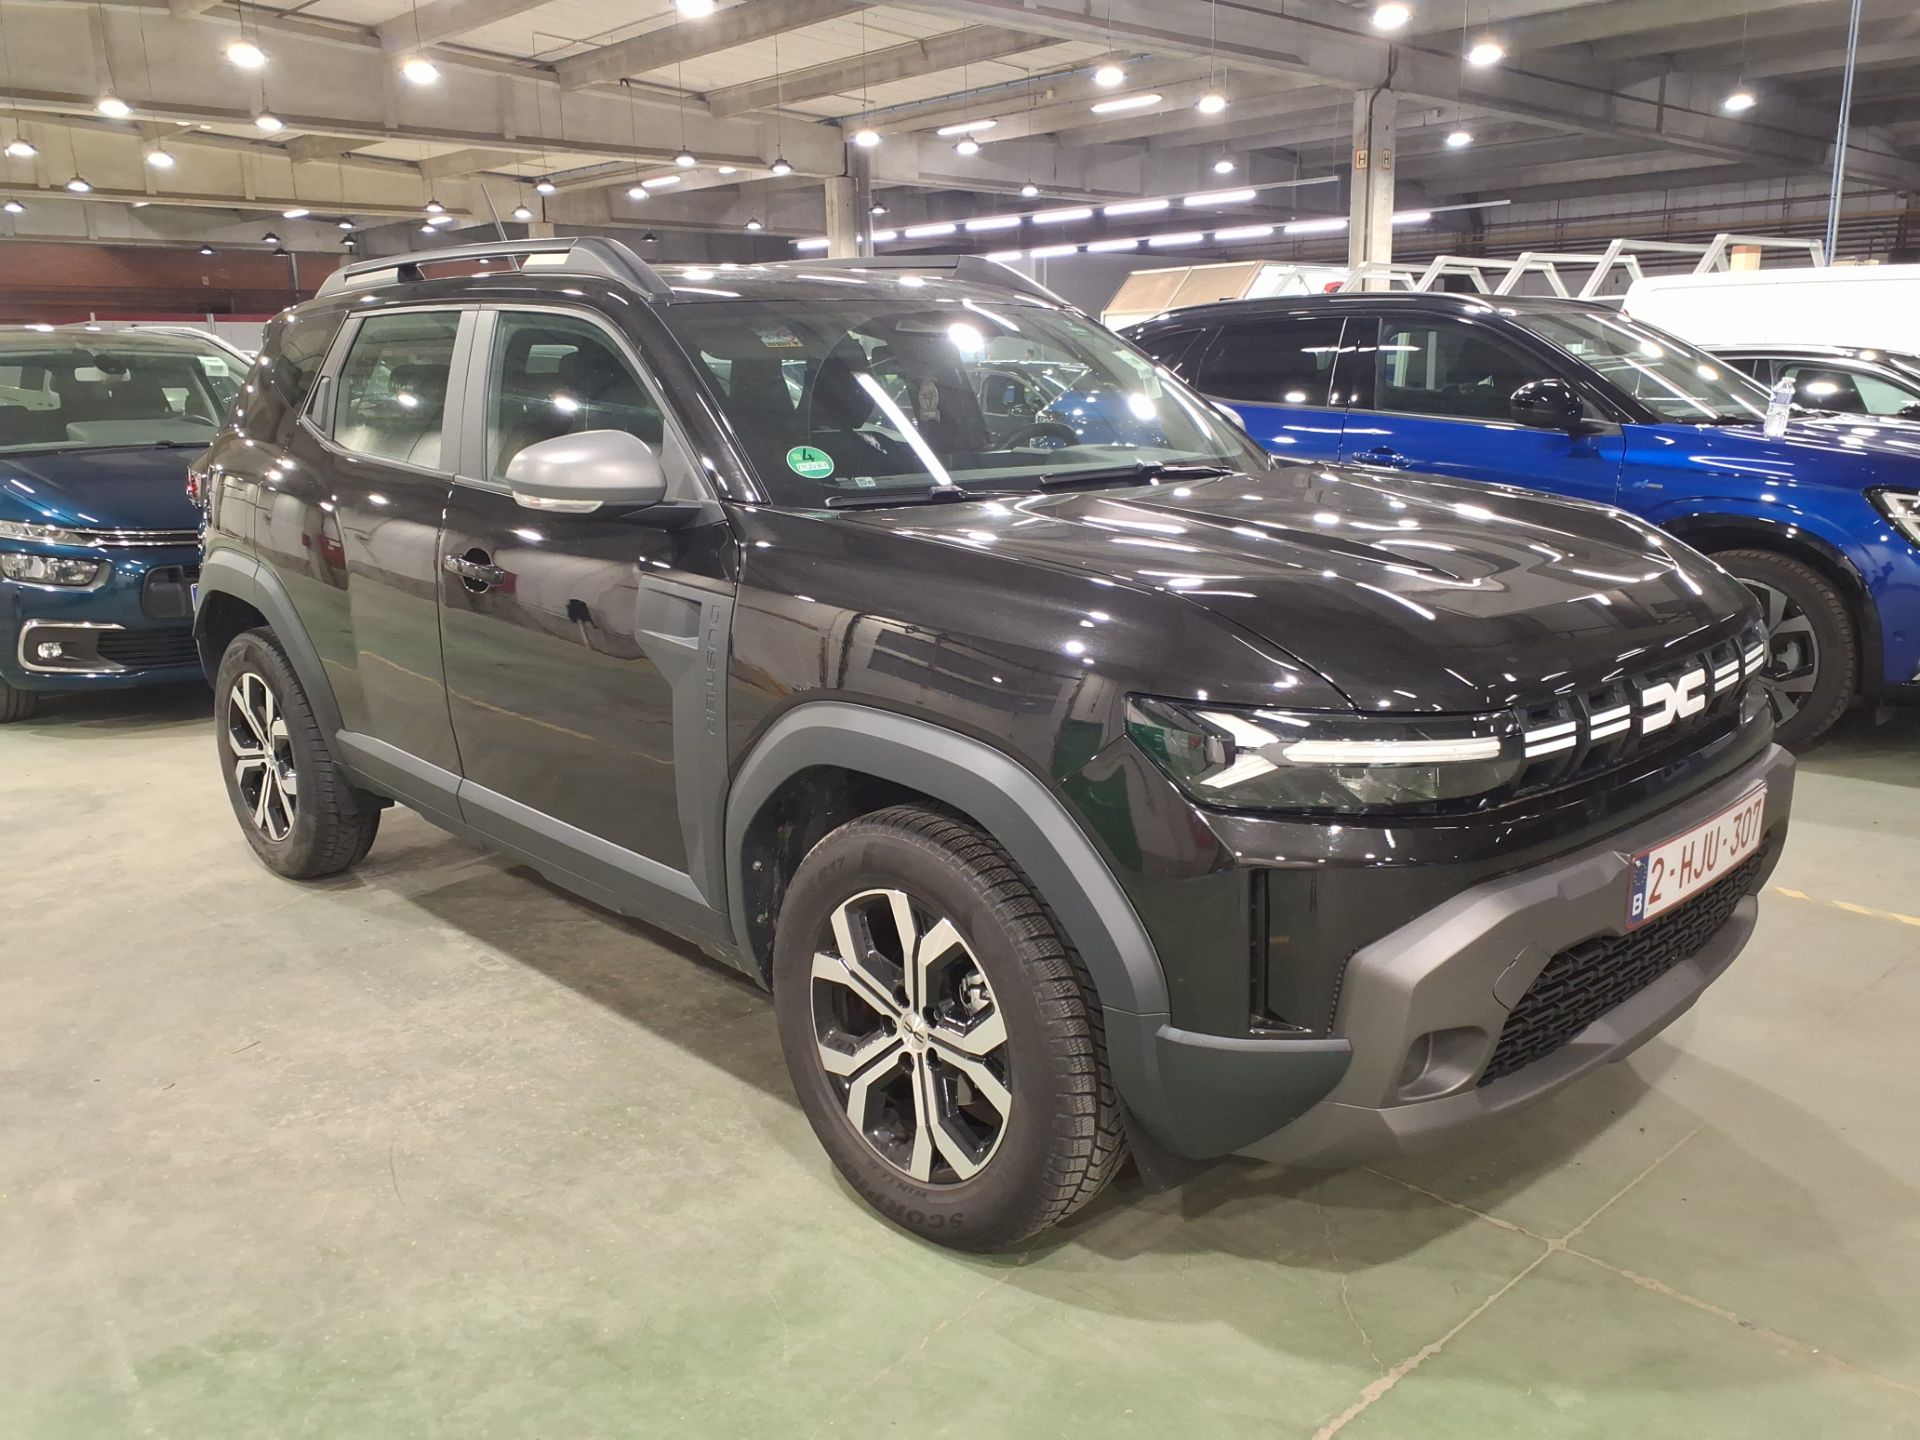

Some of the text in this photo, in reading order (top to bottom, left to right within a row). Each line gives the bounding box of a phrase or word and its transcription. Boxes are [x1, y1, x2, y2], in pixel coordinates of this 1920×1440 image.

[1359, 152, 1366, 165] H
[1384, 152, 1390, 165] H
[802, 448, 815, 462] 4
[705, 604, 721, 736] DUSTER
[1632, 893, 1642, 916] B
